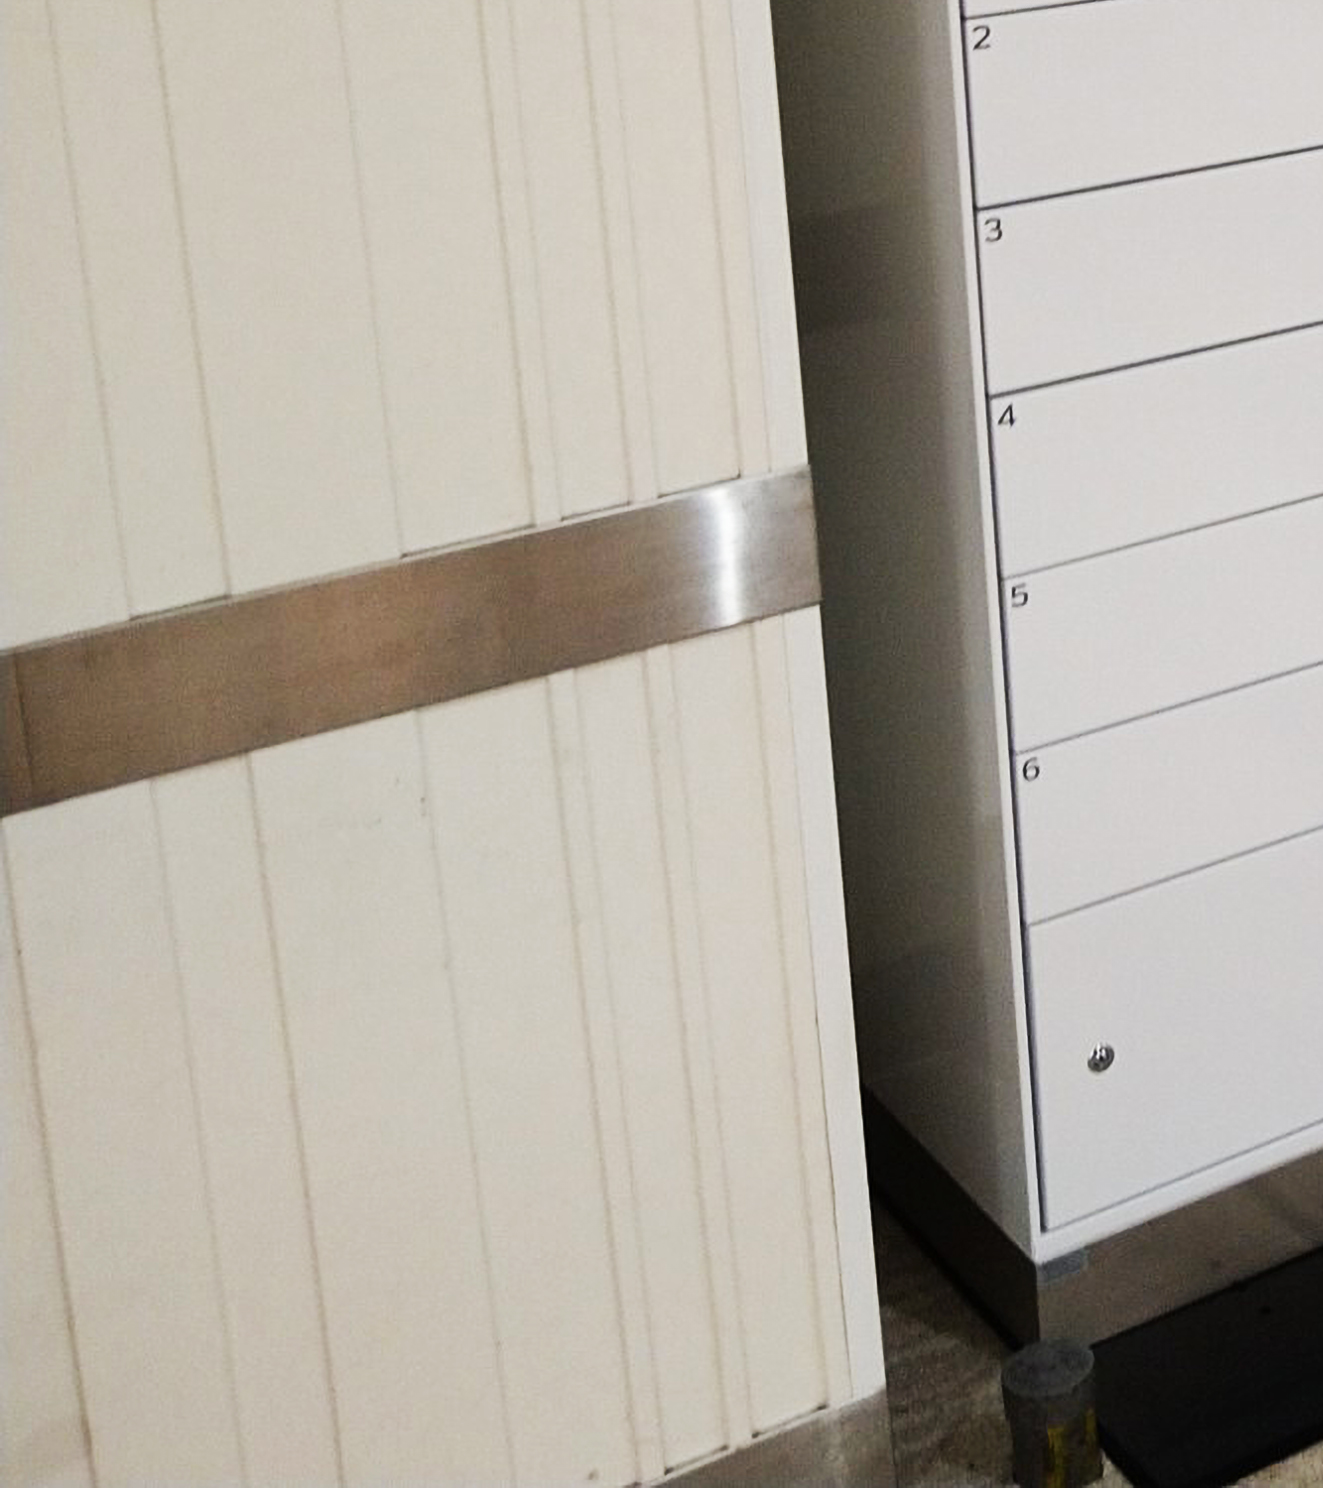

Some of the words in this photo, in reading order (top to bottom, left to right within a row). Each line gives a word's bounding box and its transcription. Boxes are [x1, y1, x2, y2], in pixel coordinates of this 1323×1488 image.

[972, 26, 991, 50] 2
[984, 219, 1002, 242] 3
[998, 405, 1015, 427] 4
[1011, 585, 1028, 608] 5
[1023, 758, 1040, 781] 6
